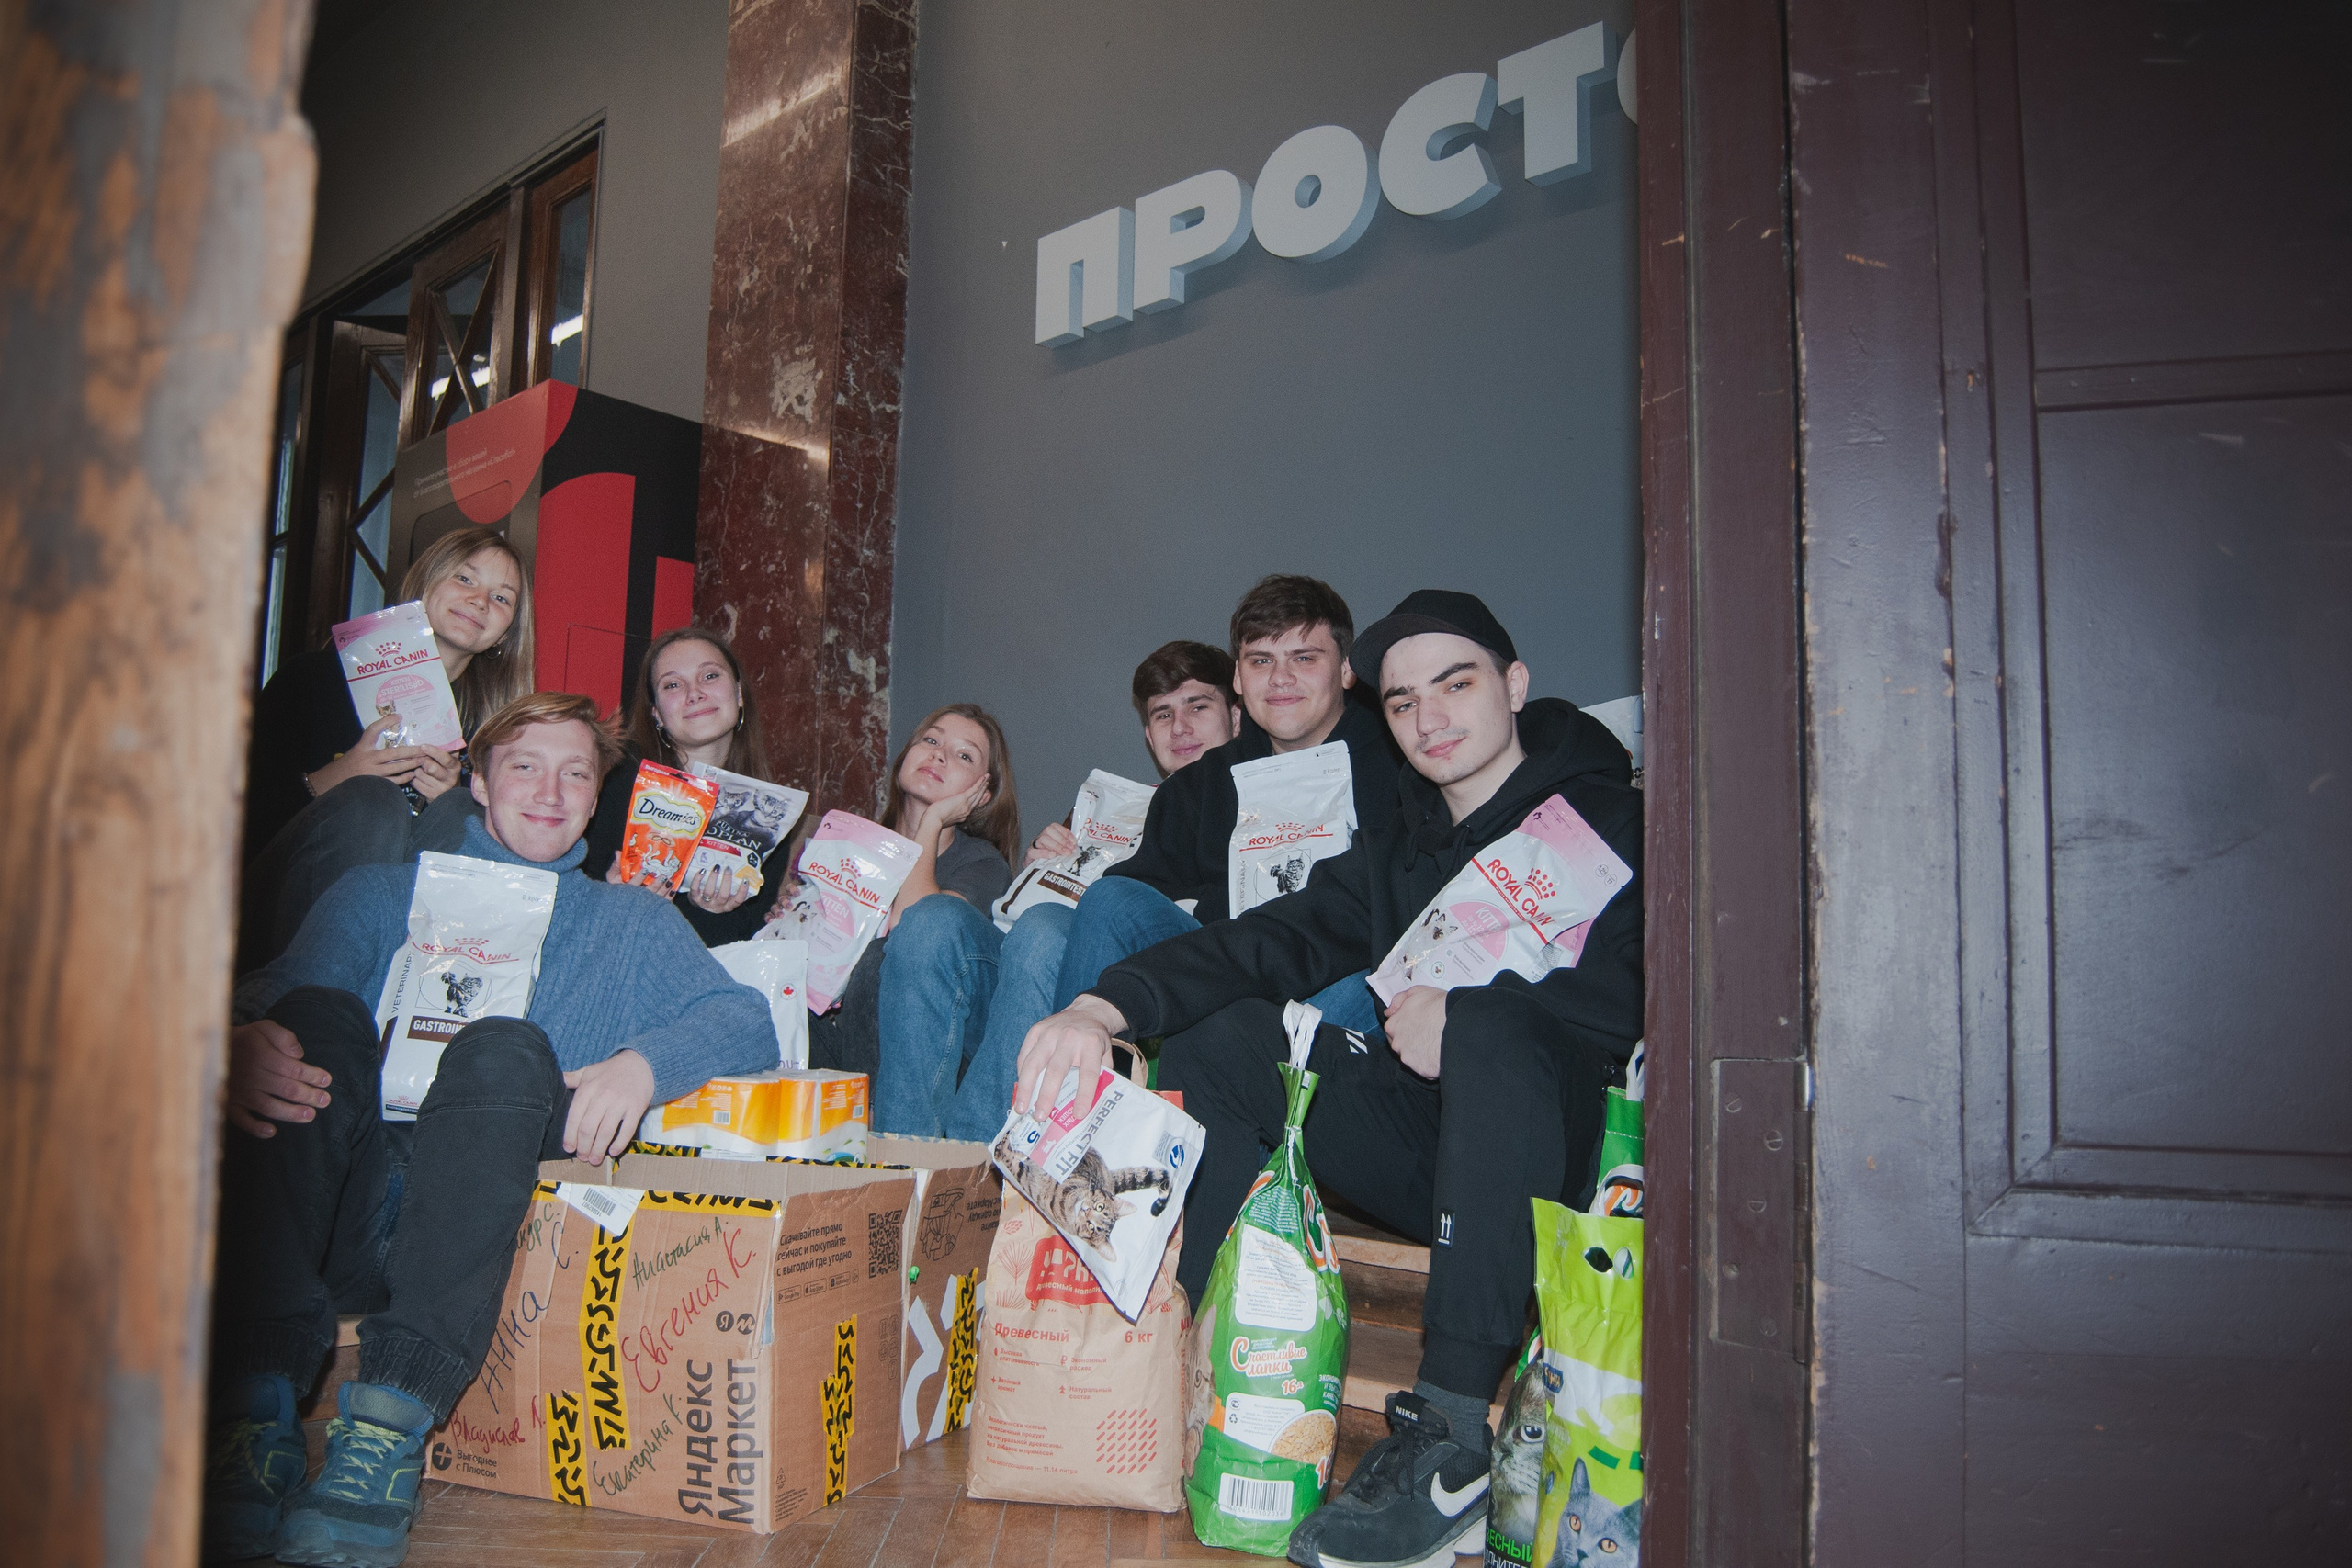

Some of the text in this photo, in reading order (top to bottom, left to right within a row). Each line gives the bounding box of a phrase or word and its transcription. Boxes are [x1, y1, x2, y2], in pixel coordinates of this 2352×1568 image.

[1035, 19, 1639, 348] ПРОСТ
[356, 649, 429, 675] ROYAL CANIN
[380, 679, 424, 696] STERILISED
[639, 797, 700, 826] Dreamies
[706, 840, 729, 851] KITTEN
[717, 829, 762, 851] PLAN
[1100, 832, 1132, 843] CANIN
[1250, 823, 1325, 846] ROYAL CANIN
[808, 861, 881, 904] ROYAL CANIN
[1487, 858, 1519, 903] ROYAL
[421, 942, 465, 955] ROYAL
[413, 1019, 466, 1035] GASTROIN
[1075, 1090, 1124, 1155] PERFECT
[1055, 1150, 1080, 1176] FIT
[966, 1197, 994, 1211] Маркете
[967, 1210, 993, 1223] одежду
[780, 1223, 843, 1247] Скачивайте прямо
[776, 1236, 846, 1262] сейчас и покупайте
[776, 1250, 853, 1277] с выгодой где угодно
[1074, 1286, 1102, 1295] наполн
[621, 1227, 757, 1393] Евгения К.
[994, 1322, 1153, 1344] Древесный 6 кг
[1001, 1348, 1023, 1358] Высокая
[1230, 1337, 1307, 1372] Счастливые
[1246, 1360, 1292, 1377] лапки
[997, 1384, 1016, 1393] аромат
[998, 1376, 1021, 1386] Хвойный
[1395, 1405, 1419, 1421] NIKE
[449, 1409, 526, 1454] Владислав
[678, 1359, 718, 1518] Яндекс
[717, 1358, 763, 1525] Маркет
[993, 1435, 1028, 1445] натуральной
[1028, 1441, 1064, 1450] древесины.
[593, 1393, 683, 1497] Екатерина К.
[457, 1450, 498, 1468] Выгоднее
[986, 1456, 1035, 1471] Влагопоглощение
[462, 1463, 497, 1479] Плюсом
